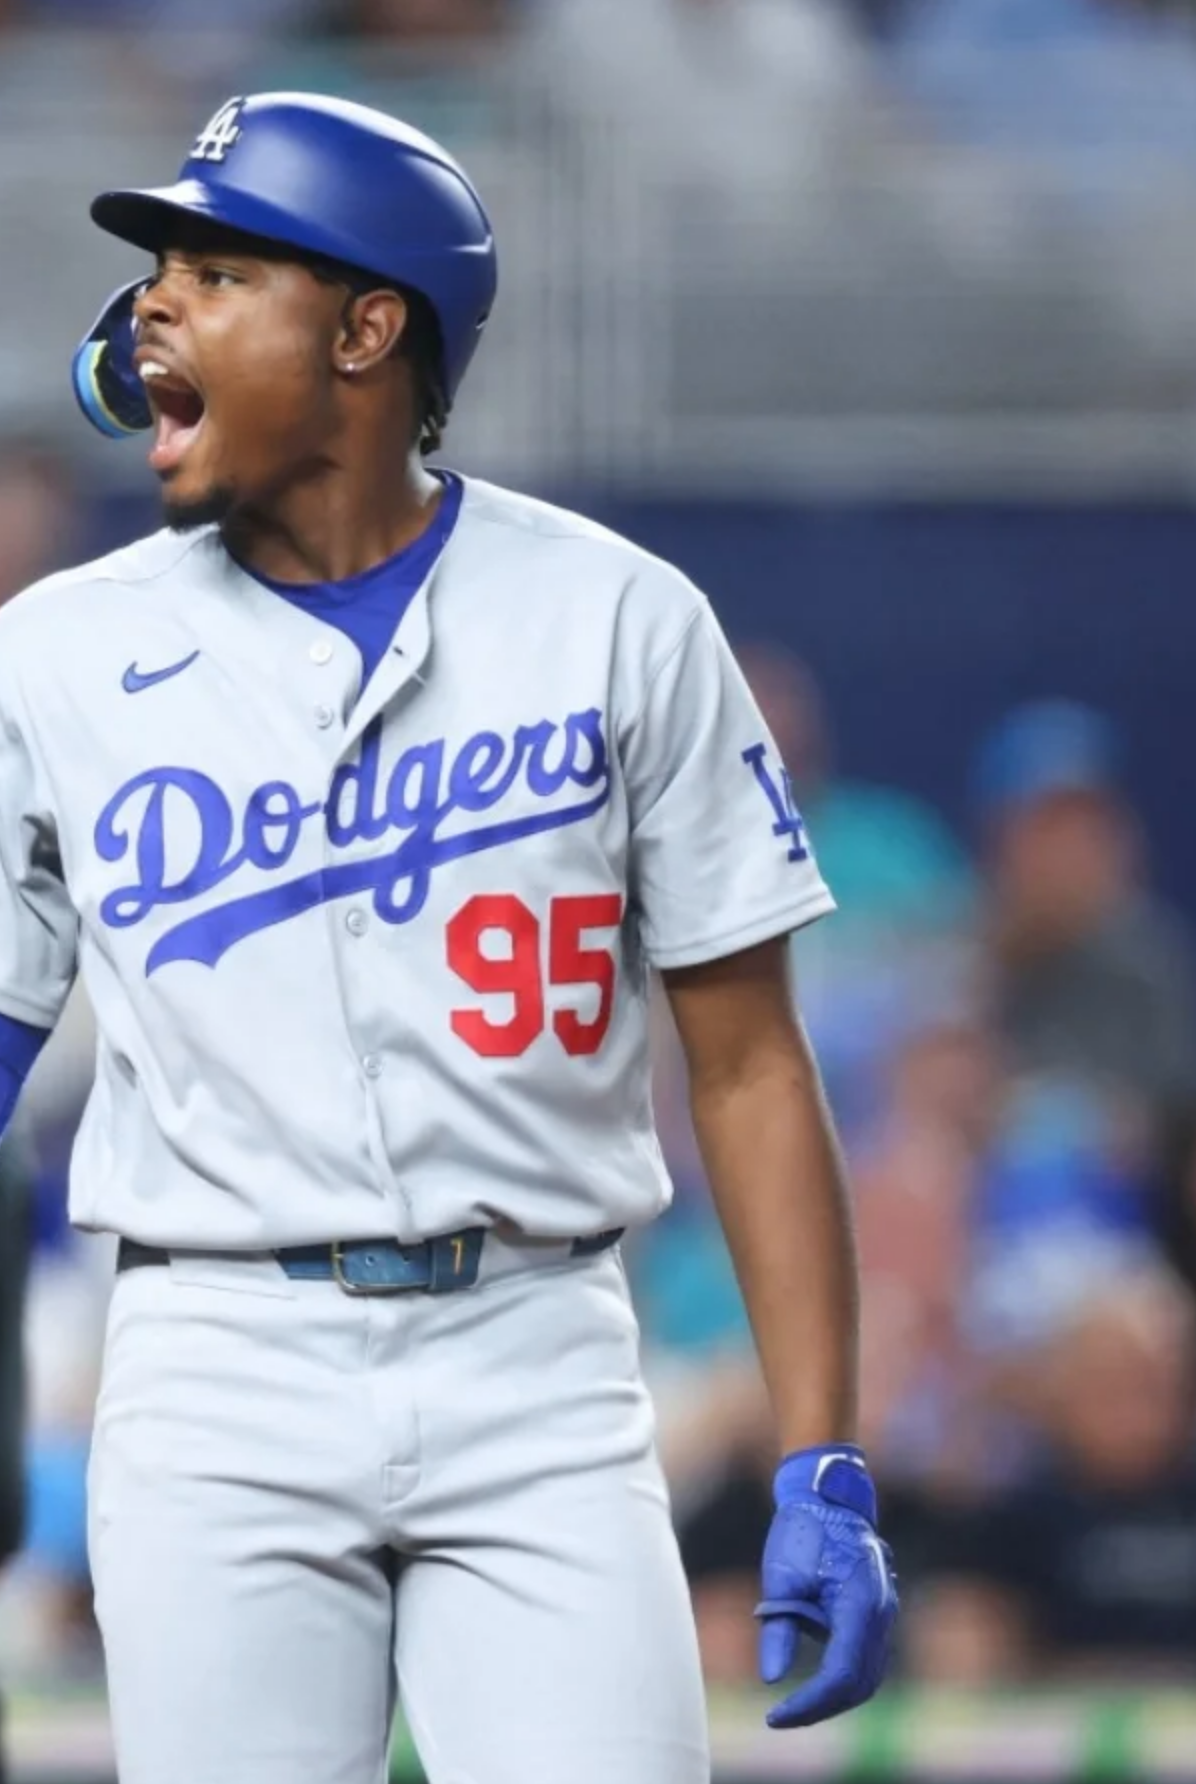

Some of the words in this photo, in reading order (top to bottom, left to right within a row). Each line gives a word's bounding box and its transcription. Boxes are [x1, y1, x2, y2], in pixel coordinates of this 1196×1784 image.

[190, 96, 244, 161] LA
[94, 707, 611, 927] Dodgers
[445, 893, 624, 1057] 95
